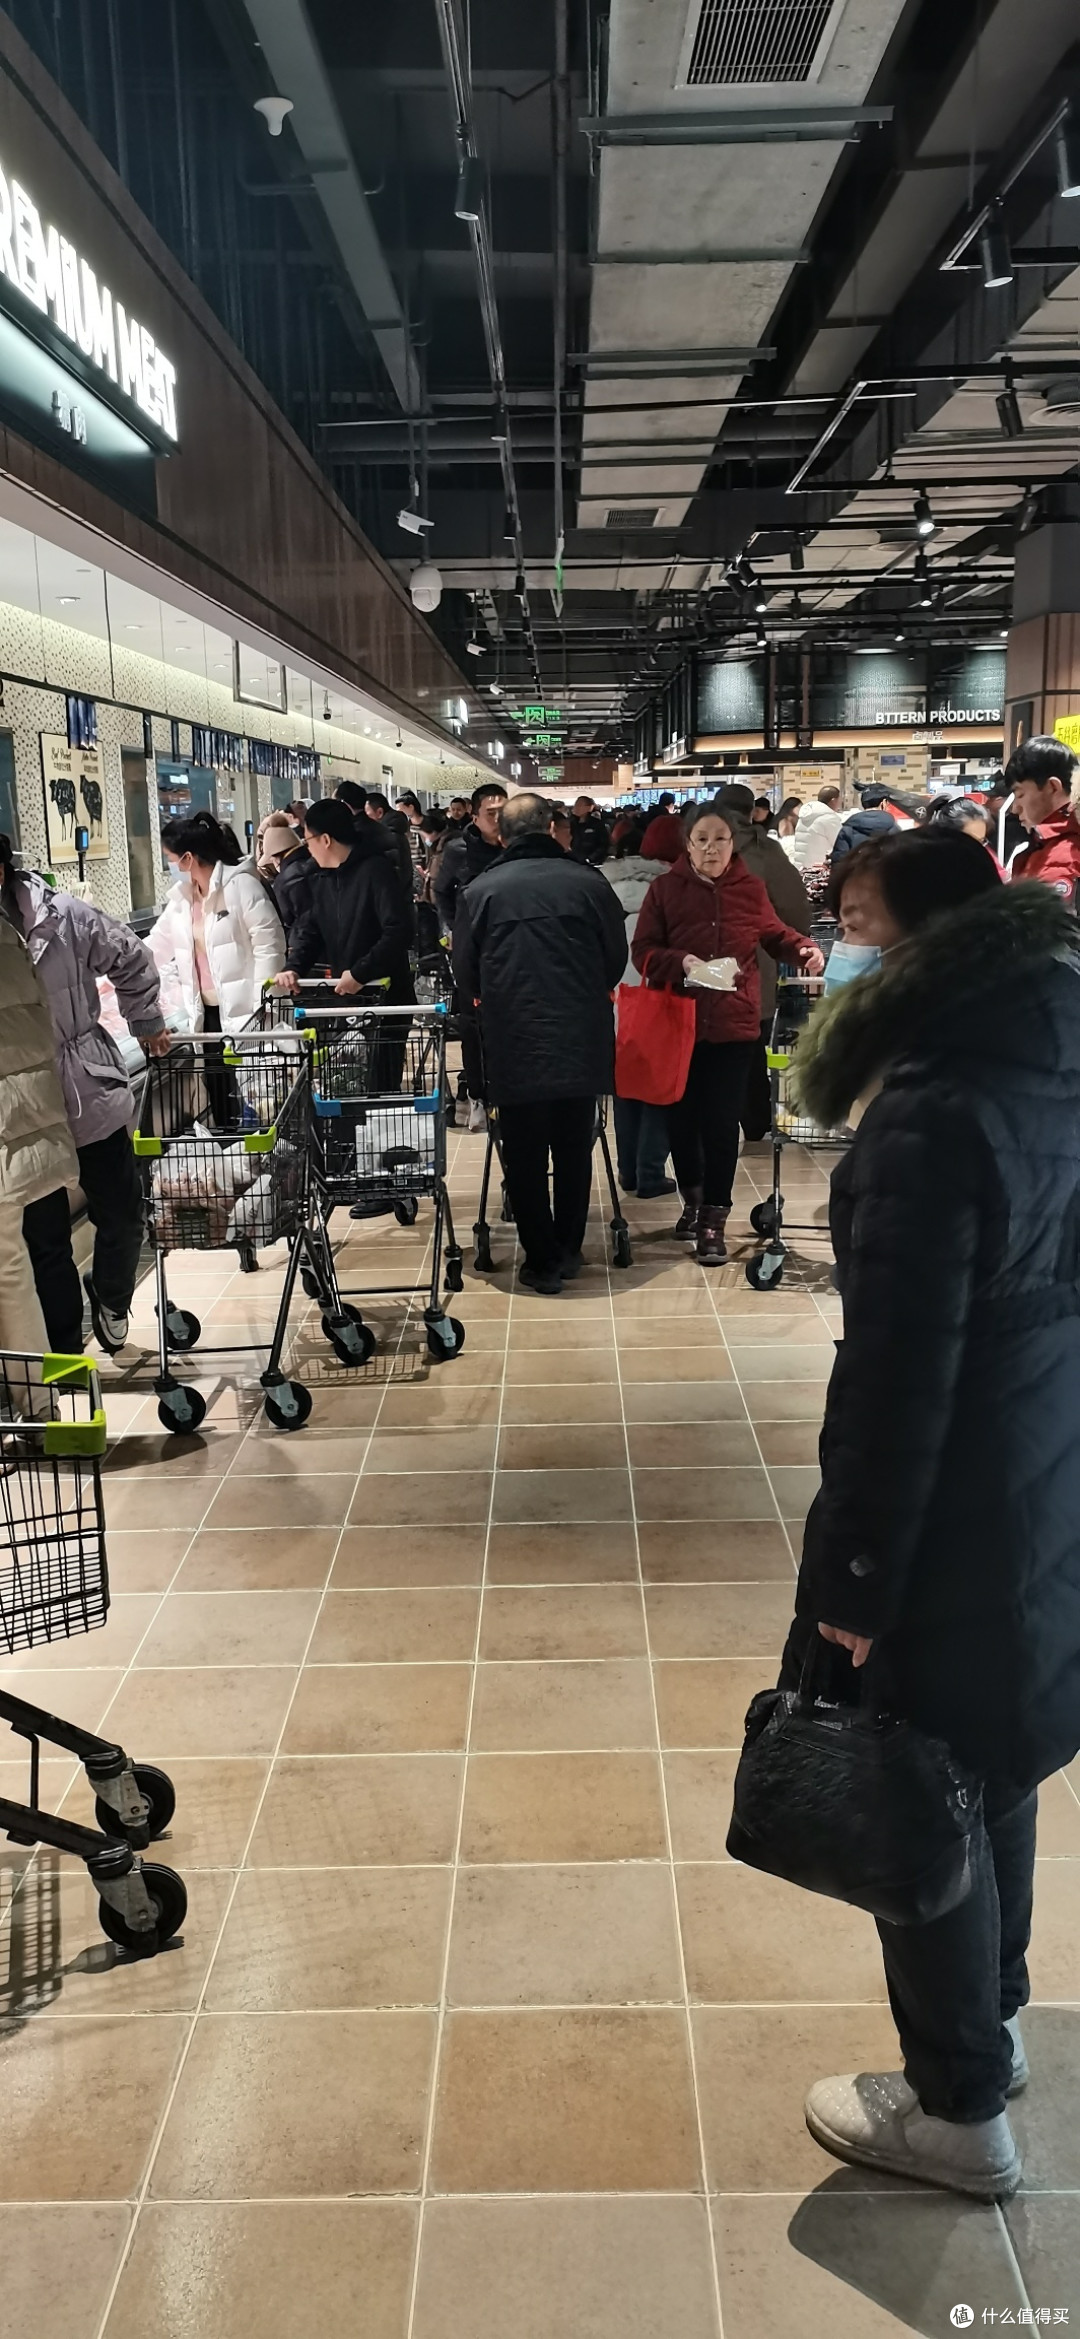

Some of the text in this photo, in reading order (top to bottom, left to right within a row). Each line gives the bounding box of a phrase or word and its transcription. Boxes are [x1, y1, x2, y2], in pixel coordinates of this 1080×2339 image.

[117, 301, 178, 442] MEAT
[875, 709, 1001, 725] BTTERN PRODUCTS
